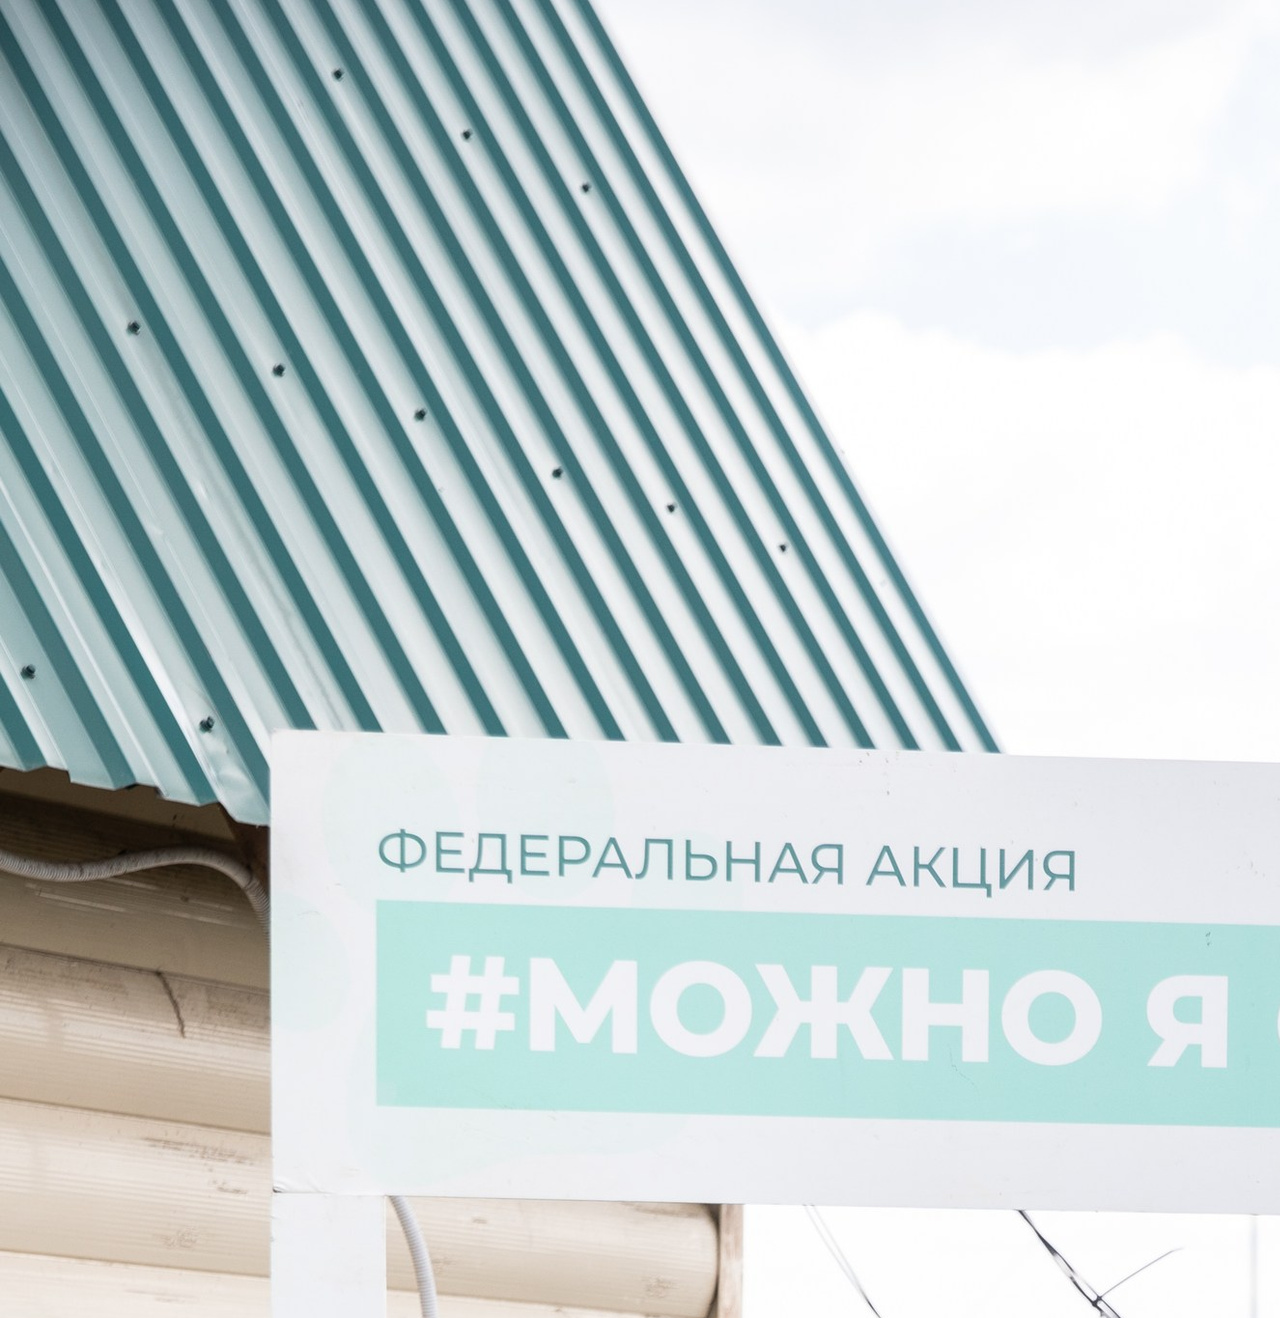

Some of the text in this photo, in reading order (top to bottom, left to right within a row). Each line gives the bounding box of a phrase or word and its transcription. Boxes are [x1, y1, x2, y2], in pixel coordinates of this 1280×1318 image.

[379, 828, 1076, 894] ФЕДЕРАЛЬНАЯ АКЦИЯ
[425, 953, 1103, 1067] #МОЖНО
[1145, 973, 1229, 1069] Я
